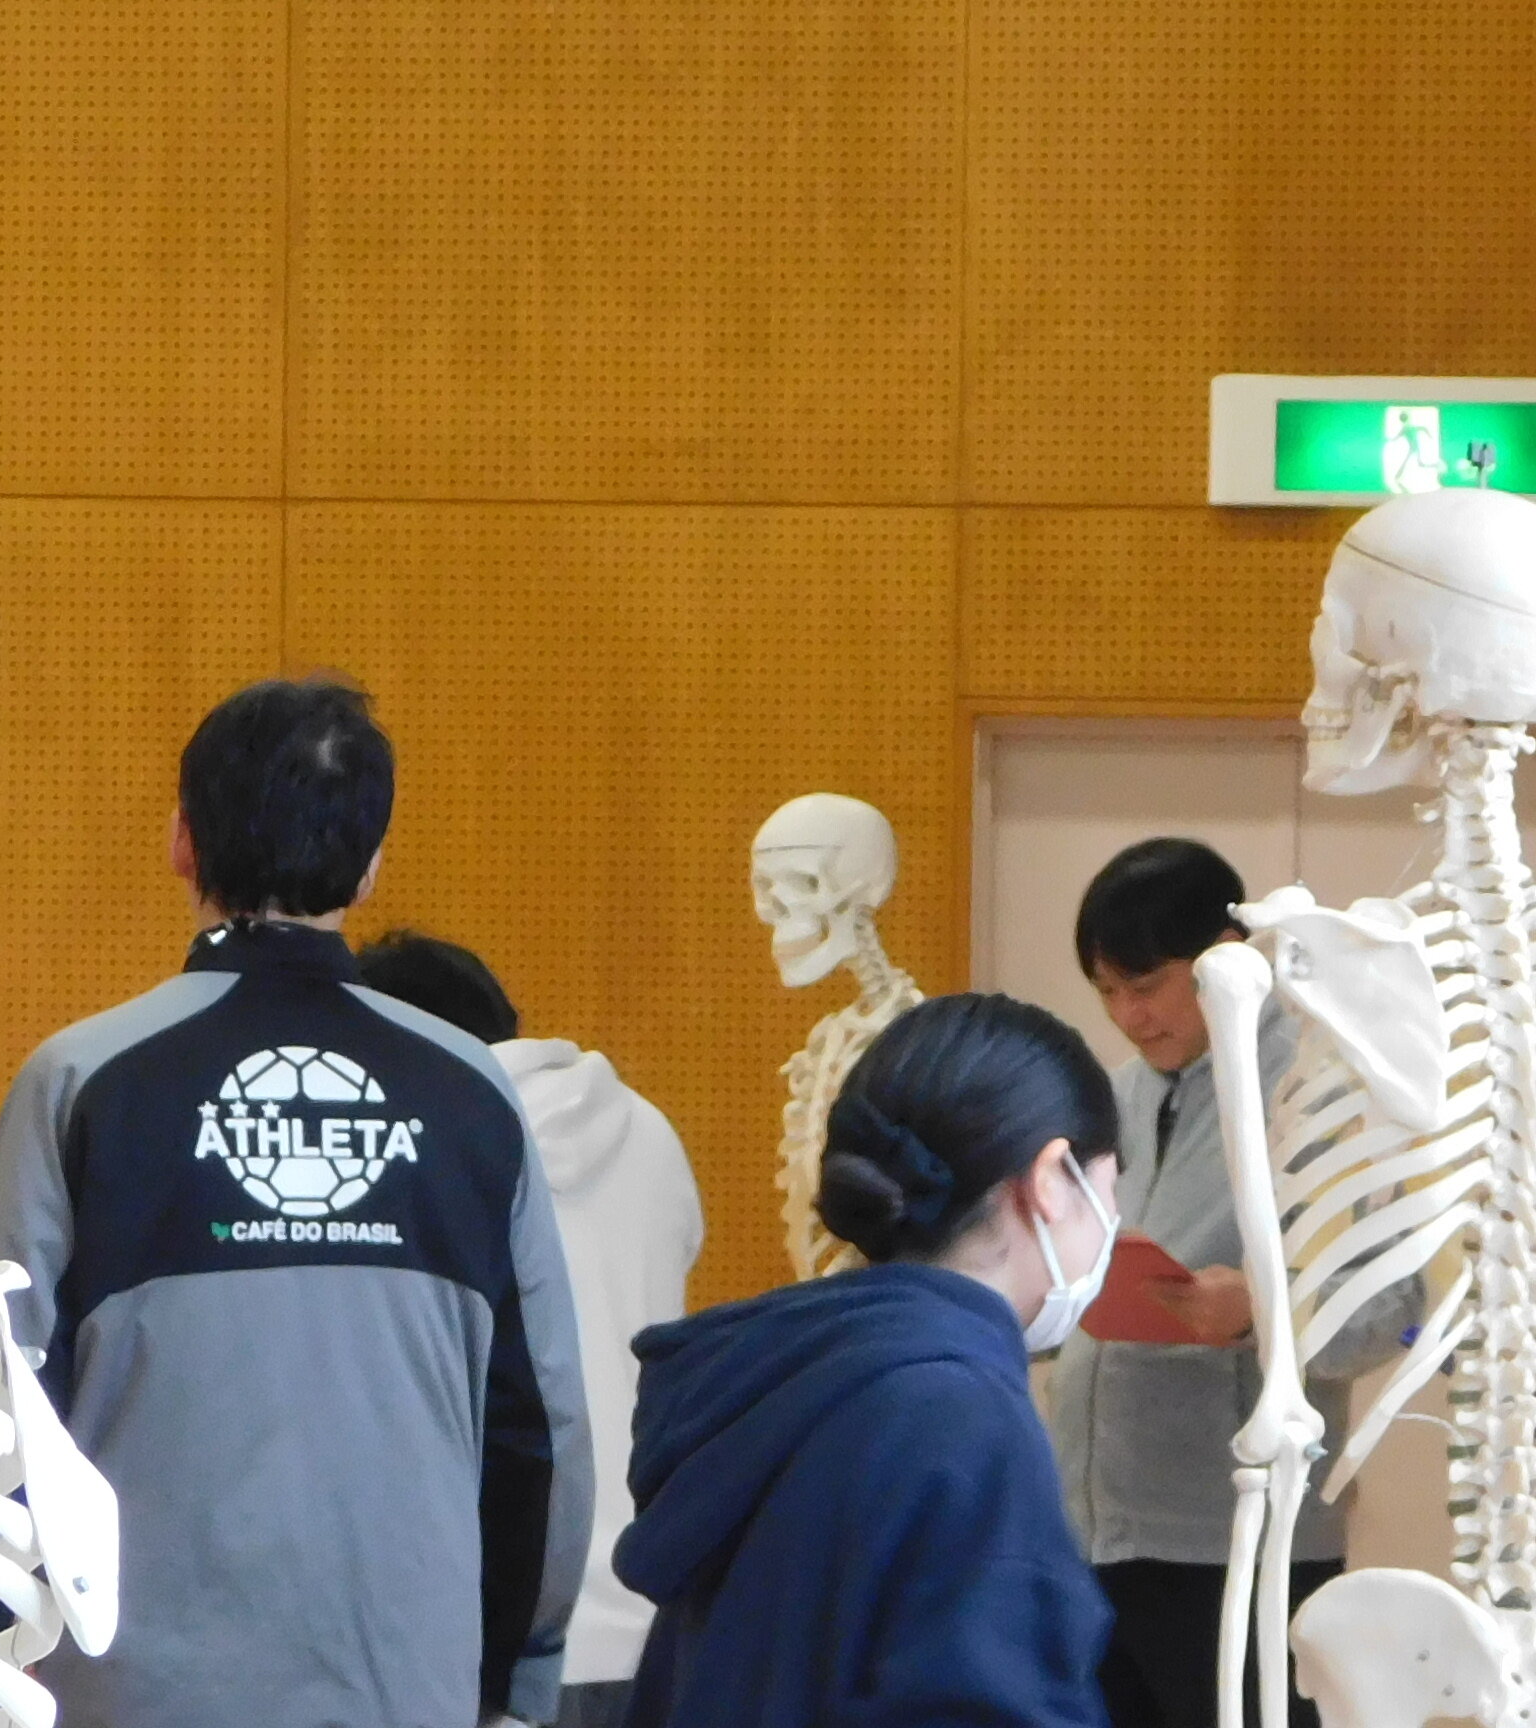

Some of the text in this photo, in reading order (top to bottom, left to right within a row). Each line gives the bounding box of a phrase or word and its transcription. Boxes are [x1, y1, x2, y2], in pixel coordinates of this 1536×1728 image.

[195, 1117, 418, 1162] ATHLETA
[231, 1217, 404, 1245] CAFÉ DO BRASIL
